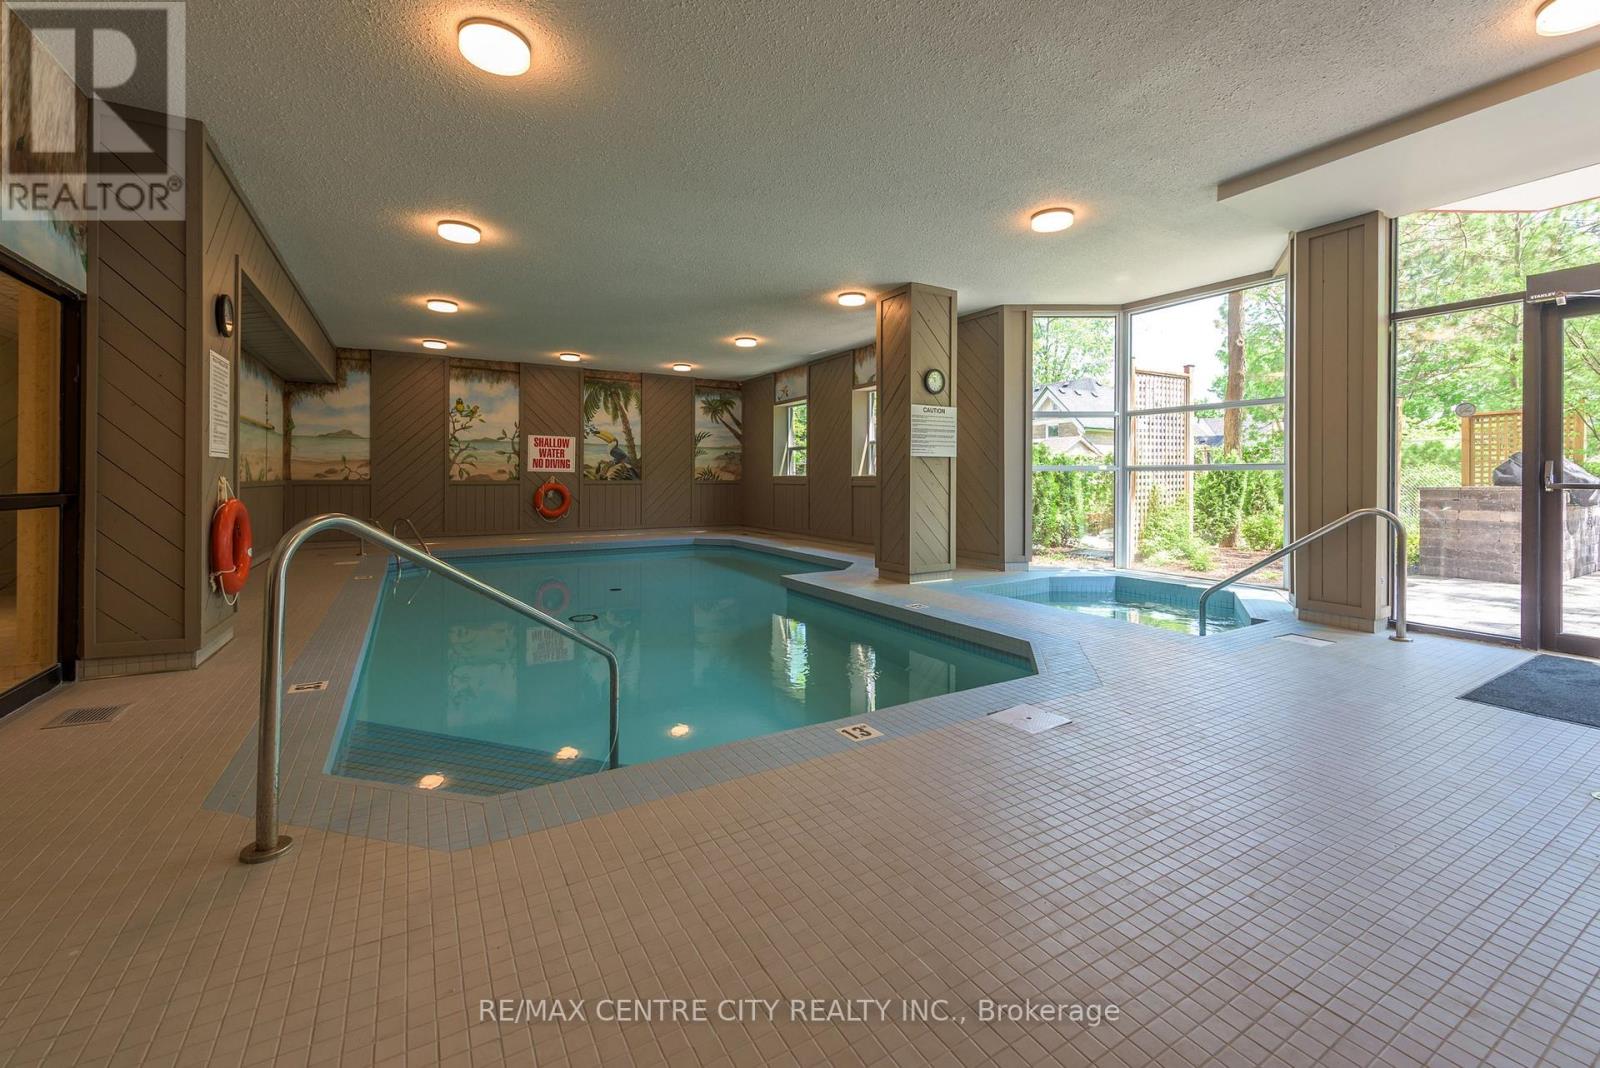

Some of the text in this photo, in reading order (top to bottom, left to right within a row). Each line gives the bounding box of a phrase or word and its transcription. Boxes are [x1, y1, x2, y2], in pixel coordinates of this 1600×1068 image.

[533, 437, 570, 448] SHALLOW
[538, 448, 565, 458] WATER
[532, 459, 570, 469] NO DIVING
